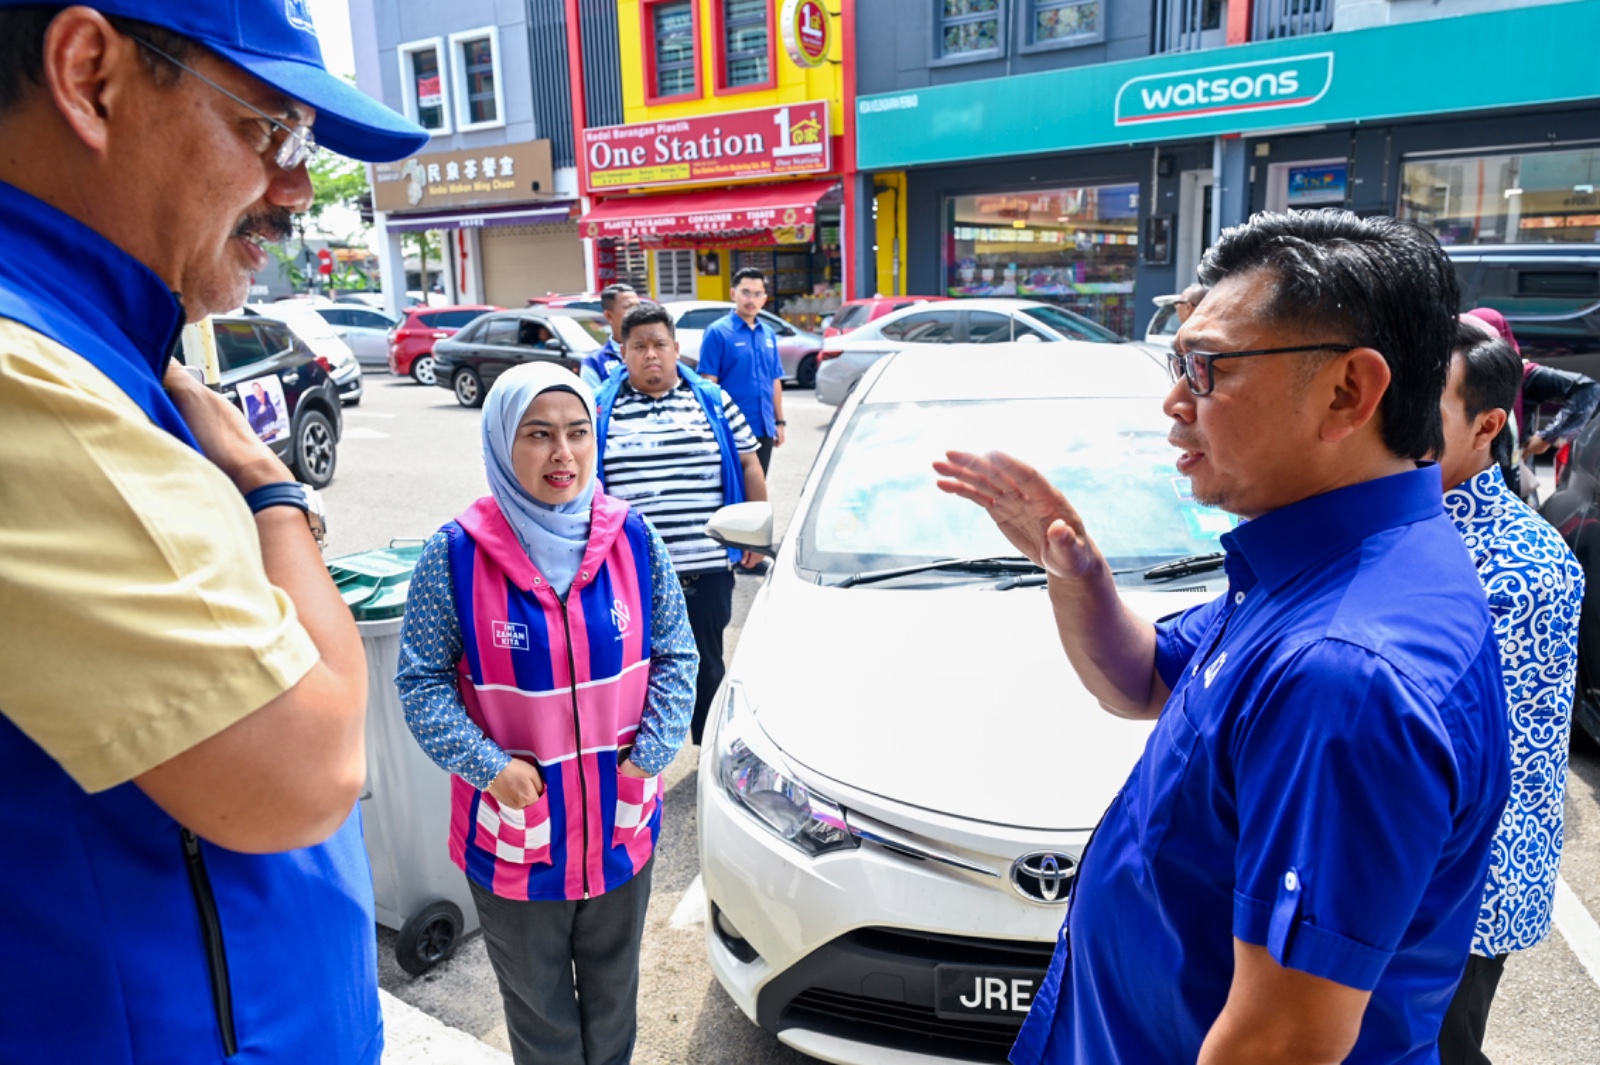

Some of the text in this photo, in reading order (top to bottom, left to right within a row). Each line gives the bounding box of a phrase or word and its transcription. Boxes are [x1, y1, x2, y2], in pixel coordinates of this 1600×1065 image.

[1141, 70, 1299, 110] watsons
[613, 126, 655, 139] Barangan
[656, 120, 690, 134] Plastik
[590, 142, 647, 169] One
[654, 127, 765, 164] Station
[604, 219, 632, 230] PLASTIC
[634, 216, 676, 228] PACKAGING
[688, 212, 732, 224] CONTAINER
[495, 630, 525, 641] ZAMAN
[504, 624, 515, 632] INI
[501, 638, 520, 647] KITA
[959, 976, 1034, 1012] JRE
